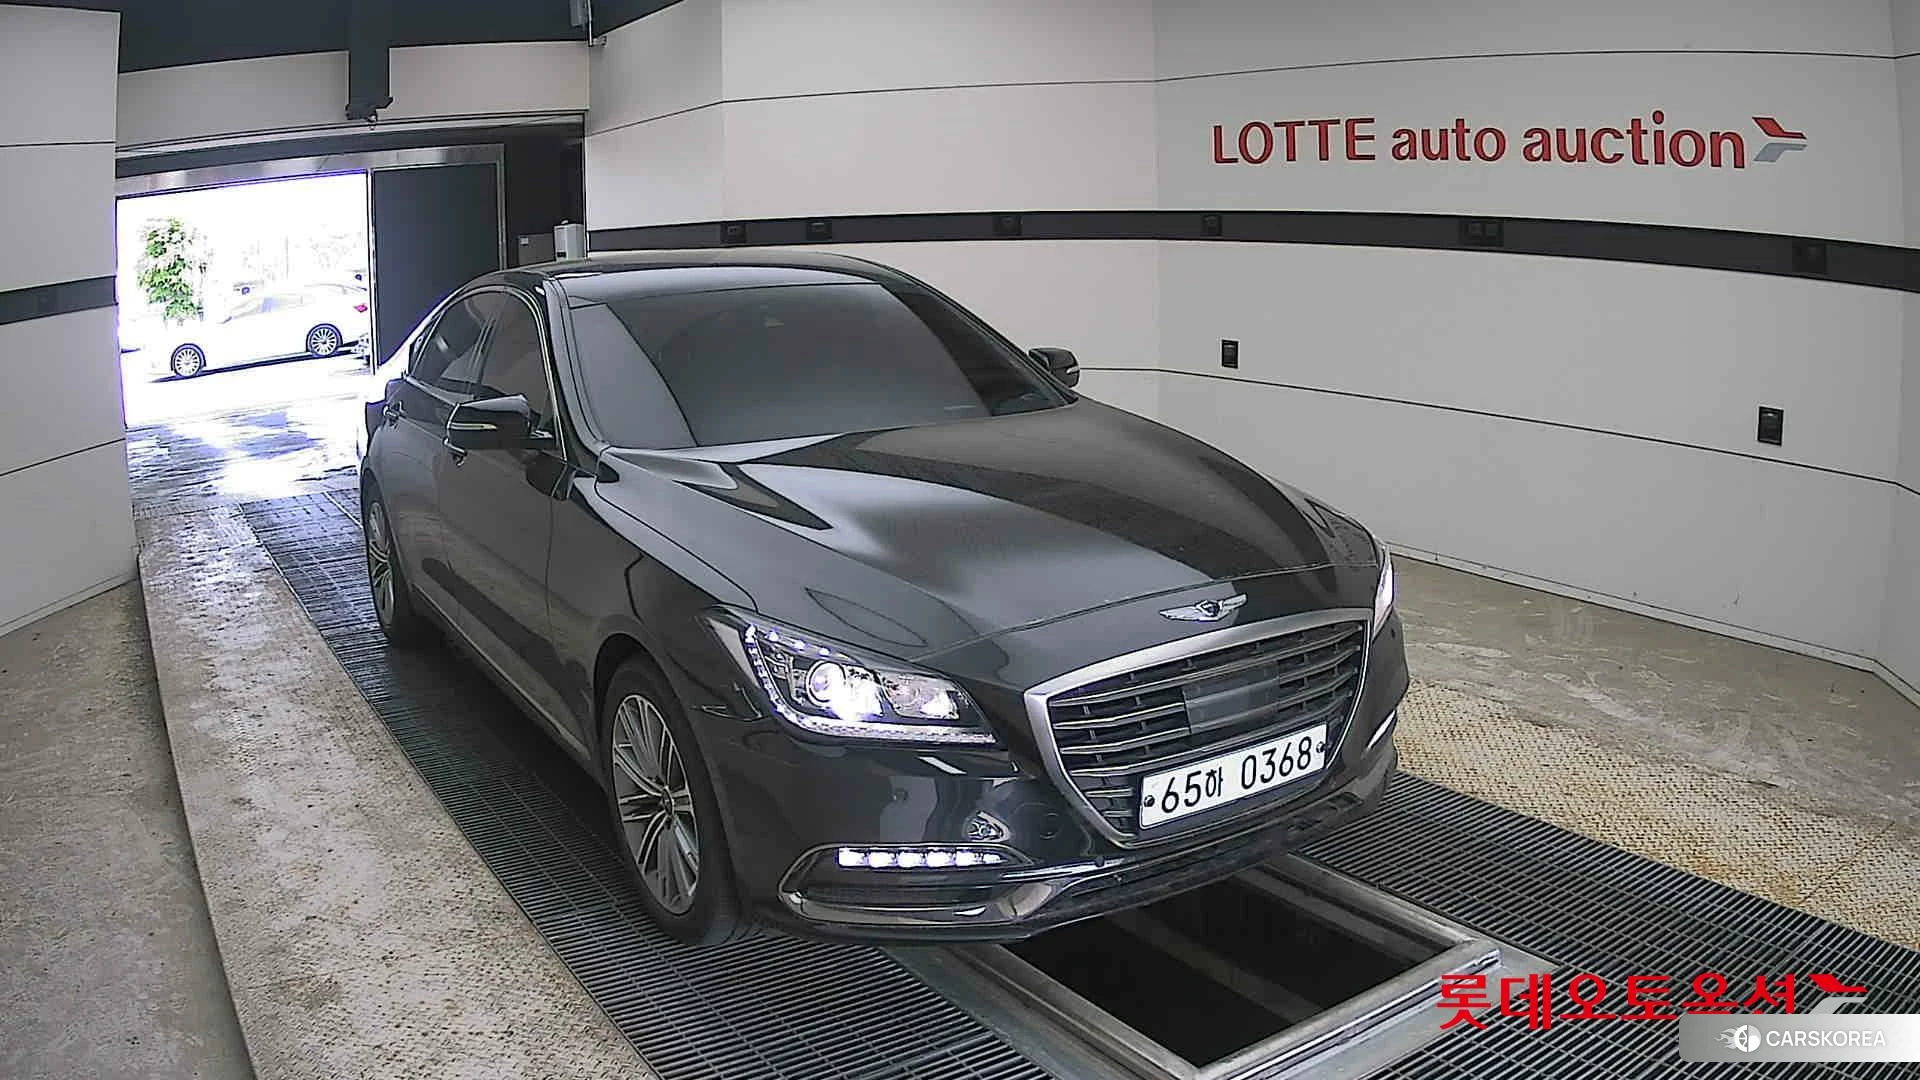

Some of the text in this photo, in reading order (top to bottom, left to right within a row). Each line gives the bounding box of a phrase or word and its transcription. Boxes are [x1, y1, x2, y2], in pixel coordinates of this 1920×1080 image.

[1213, 110, 1745, 169] LOTTE auto auction
[1161, 736, 1312, 814] 65하 0368
